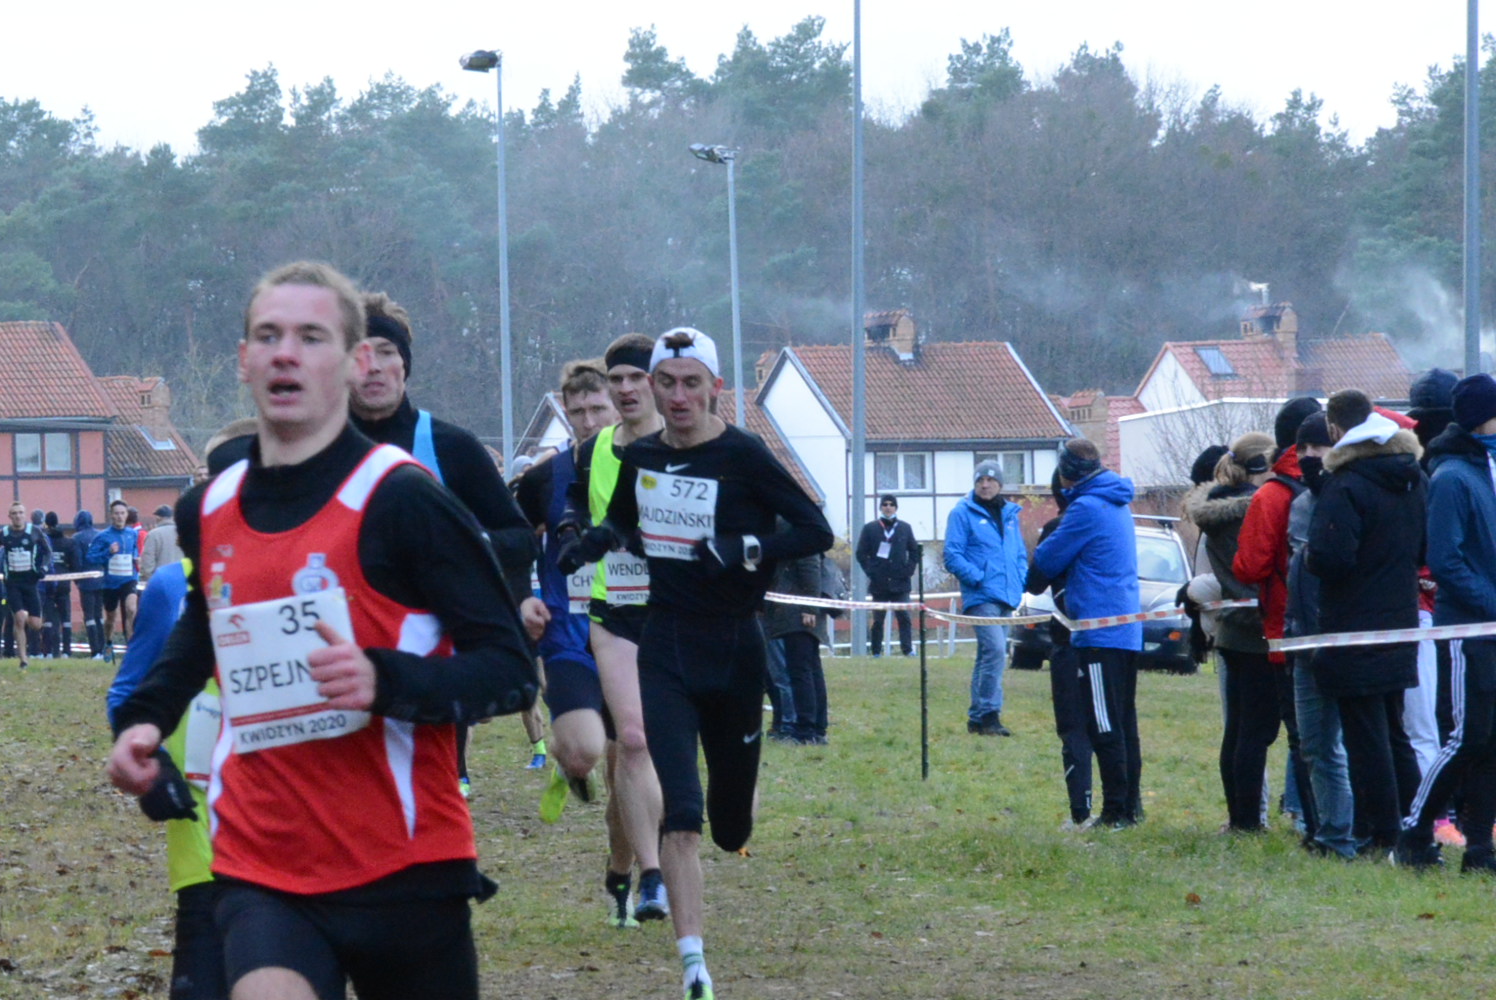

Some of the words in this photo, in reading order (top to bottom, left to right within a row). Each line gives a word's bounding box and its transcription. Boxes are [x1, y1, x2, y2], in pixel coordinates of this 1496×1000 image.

[670, 479, 709, 501] 572
[279, 600, 321, 635] 35
[239, 721, 305, 745] KWIDZYN
[310, 713, 347, 734] 2020
